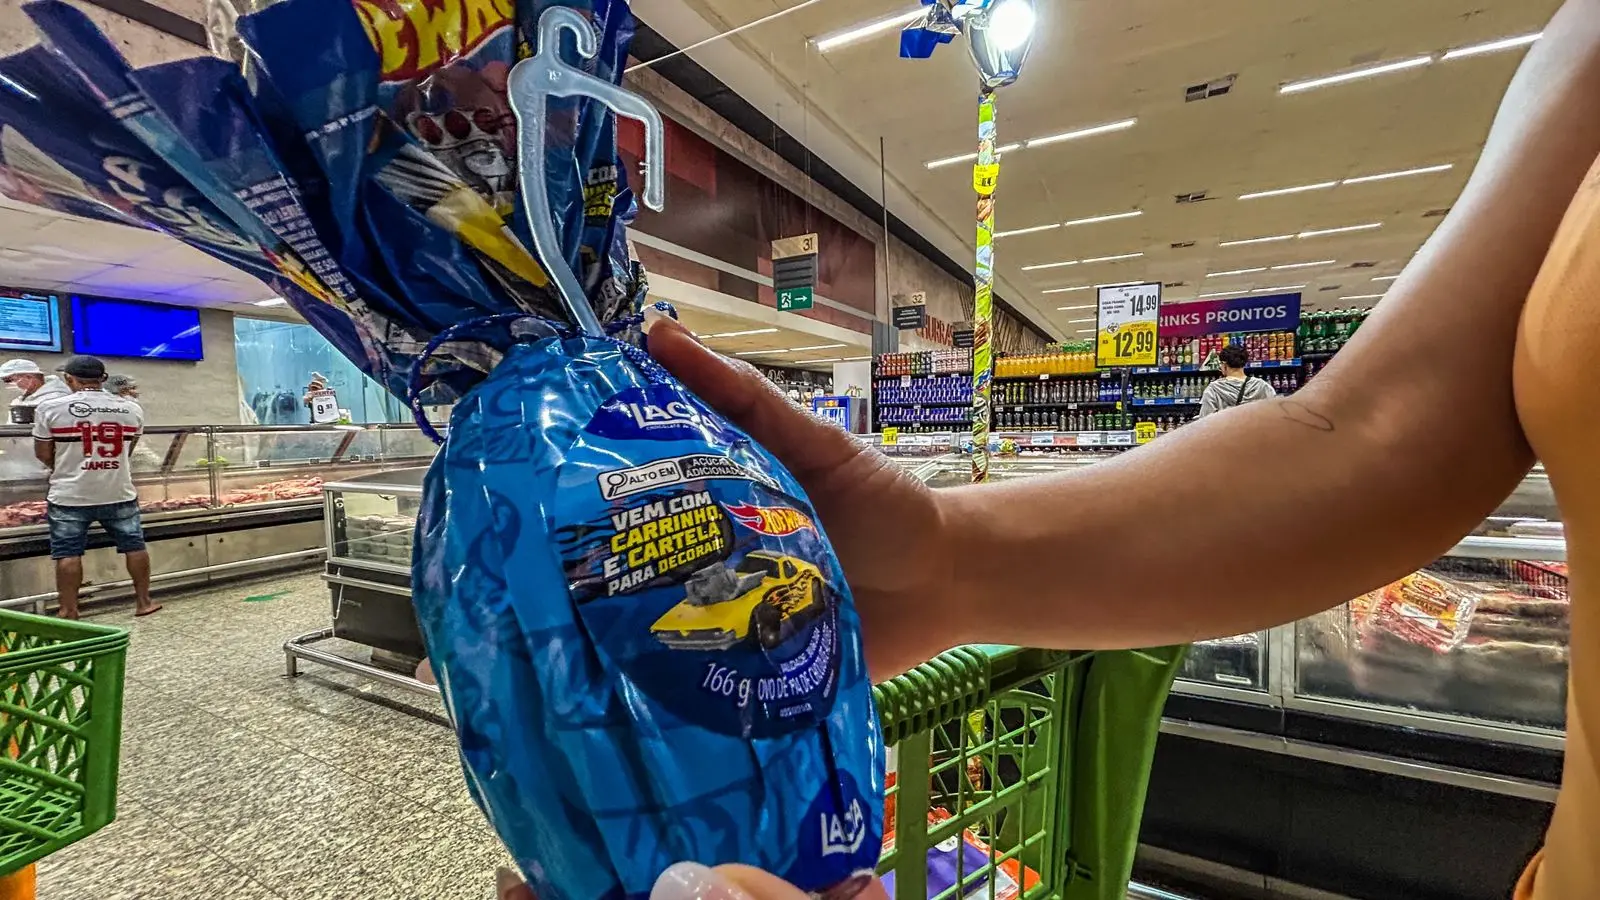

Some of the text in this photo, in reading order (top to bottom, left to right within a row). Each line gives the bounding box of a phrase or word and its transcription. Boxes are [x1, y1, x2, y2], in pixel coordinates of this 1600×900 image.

[802, 238, 813, 251] 31
[912, 295, 923, 304] 32
[1130, 294, 1157, 316] 14,99
[1205, 305, 1288, 324] PRONTOS
[1113, 330, 1154, 358] 12,99
[76, 420, 124, 458] 19
[81, 460, 120, 471] JAMES
[629, 466, 676, 485] ALTO EM
[611, 491, 713, 532] VEM COM
[610, 505, 724, 554] CARRINHO,
[603, 522, 722, 579] E CARTELA
[607, 567, 656, 597] PARA
[702, 662, 751, 707] 166 g
